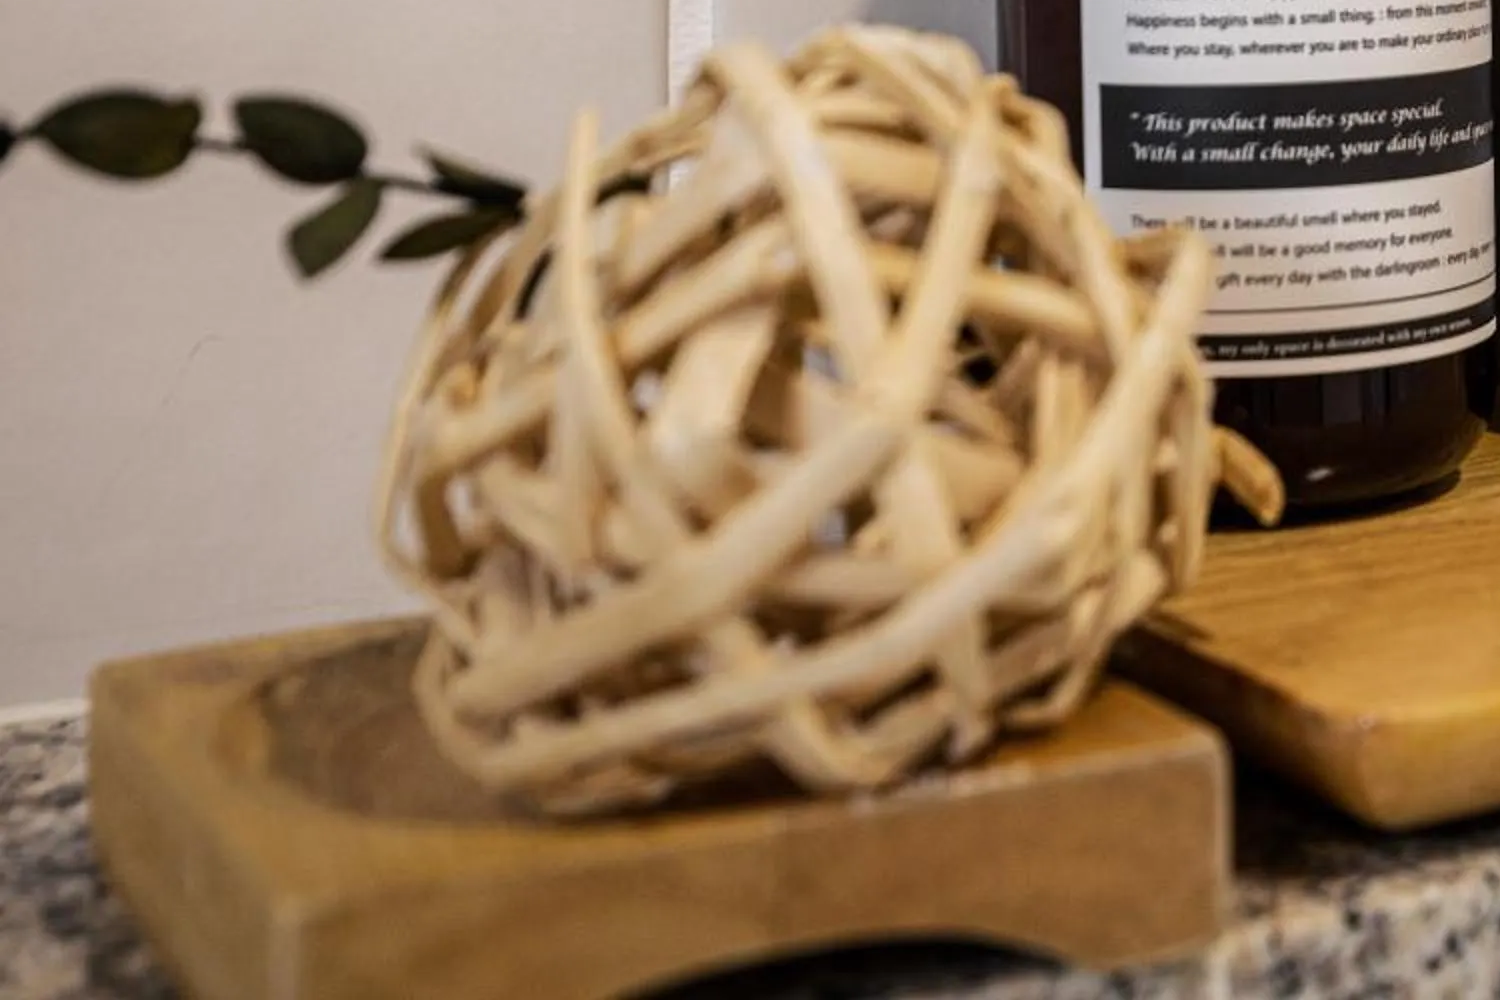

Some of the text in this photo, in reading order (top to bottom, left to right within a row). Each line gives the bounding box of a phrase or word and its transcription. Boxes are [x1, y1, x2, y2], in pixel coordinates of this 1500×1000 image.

[1127, 5, 1434, 30] Happiness begins with a small from this
[1127, 35, 1409, 59] Where you wherever you are to make
[1144, 109, 1388, 137] This product makes space
[1131, 131, 1427, 163] With a small your daily
[1234, 208, 1405, 230] beautiful smell where you
[1230, 244, 1255, 258] will
[1258, 244, 1277, 258] be
[1294, 241, 1331, 260] good
[1334, 237, 1388, 253] memory
[1389, 233, 1406, 248] for
[1244, 265, 1372, 288] every day with the
